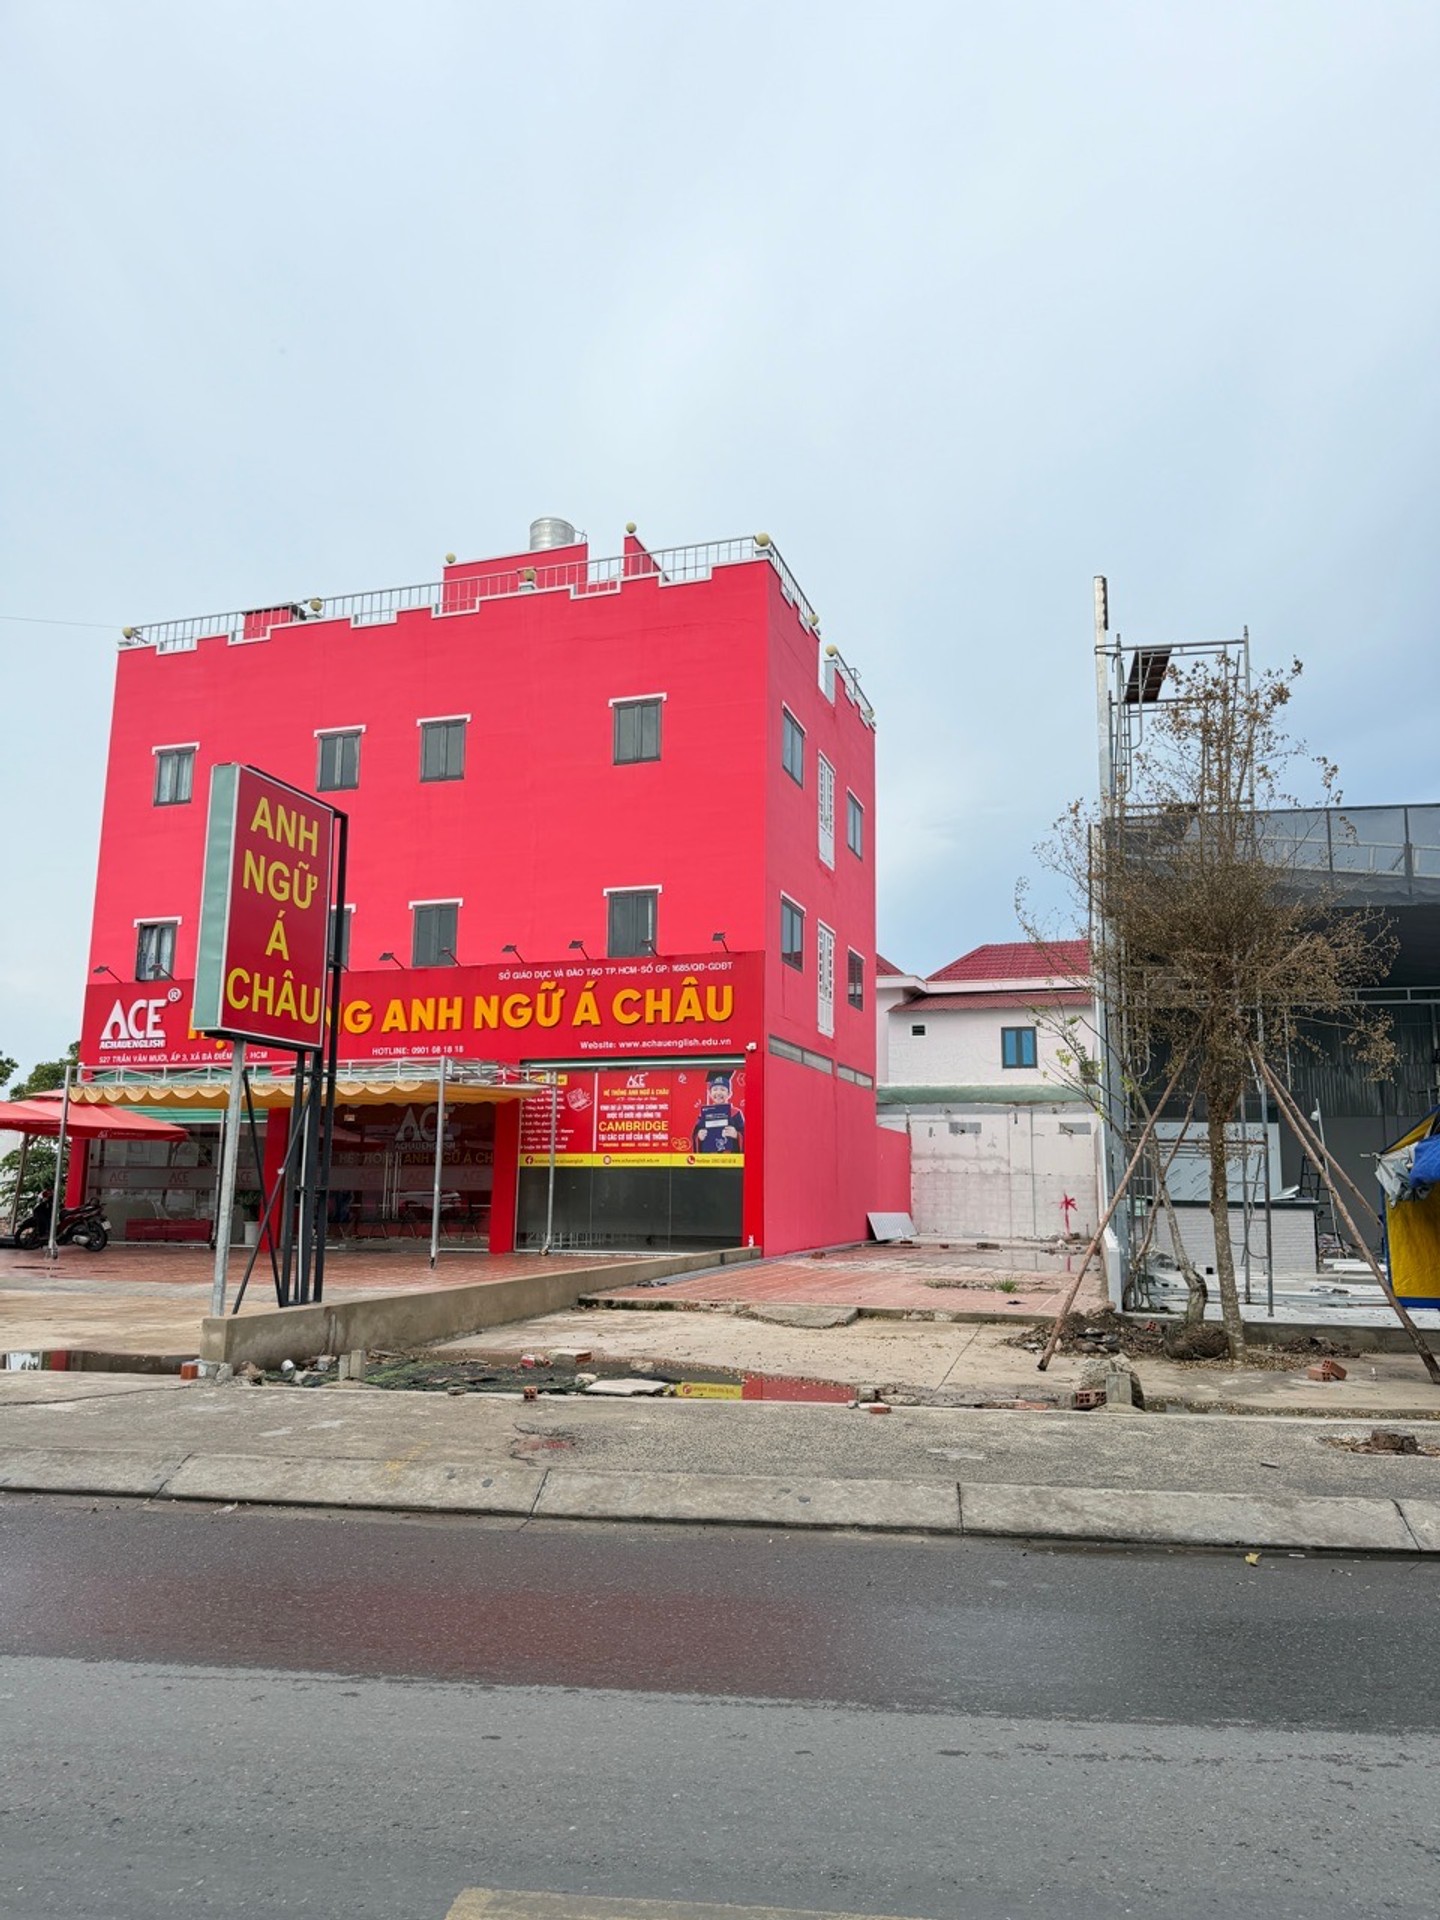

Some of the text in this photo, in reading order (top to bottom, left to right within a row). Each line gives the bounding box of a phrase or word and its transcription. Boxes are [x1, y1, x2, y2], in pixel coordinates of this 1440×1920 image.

[250, 796, 319, 857] ANH
[243, 849, 318, 909] NGỮ
[265, 910, 290, 961] Á
[512, 970, 533, 980] GIÁO
[534, 970, 552, 980] DỤC
[553, 969, 564, 978] VÀ
[566, 968, 584, 977] ĐÀO
[586, 968, 603, 978] TẠO
[226, 967, 320, 1024] CHÂU
[381, 996, 463, 1032] ANH
[474, 981, 566, 1029] NGỮ
[572, 981, 601, 1026] Á
[612, 976, 733, 1025] CHÂU
[100, 999, 167, 1039] ACE
[372, 1046, 410, 1056] HOTLINE:
[580, 1041, 616, 1050] Website:
[599, 1120, 669, 1132] CAMBRIDGE
[109, 1171, 129, 1183] ACE
[169, 1171, 190, 1183] ACE
